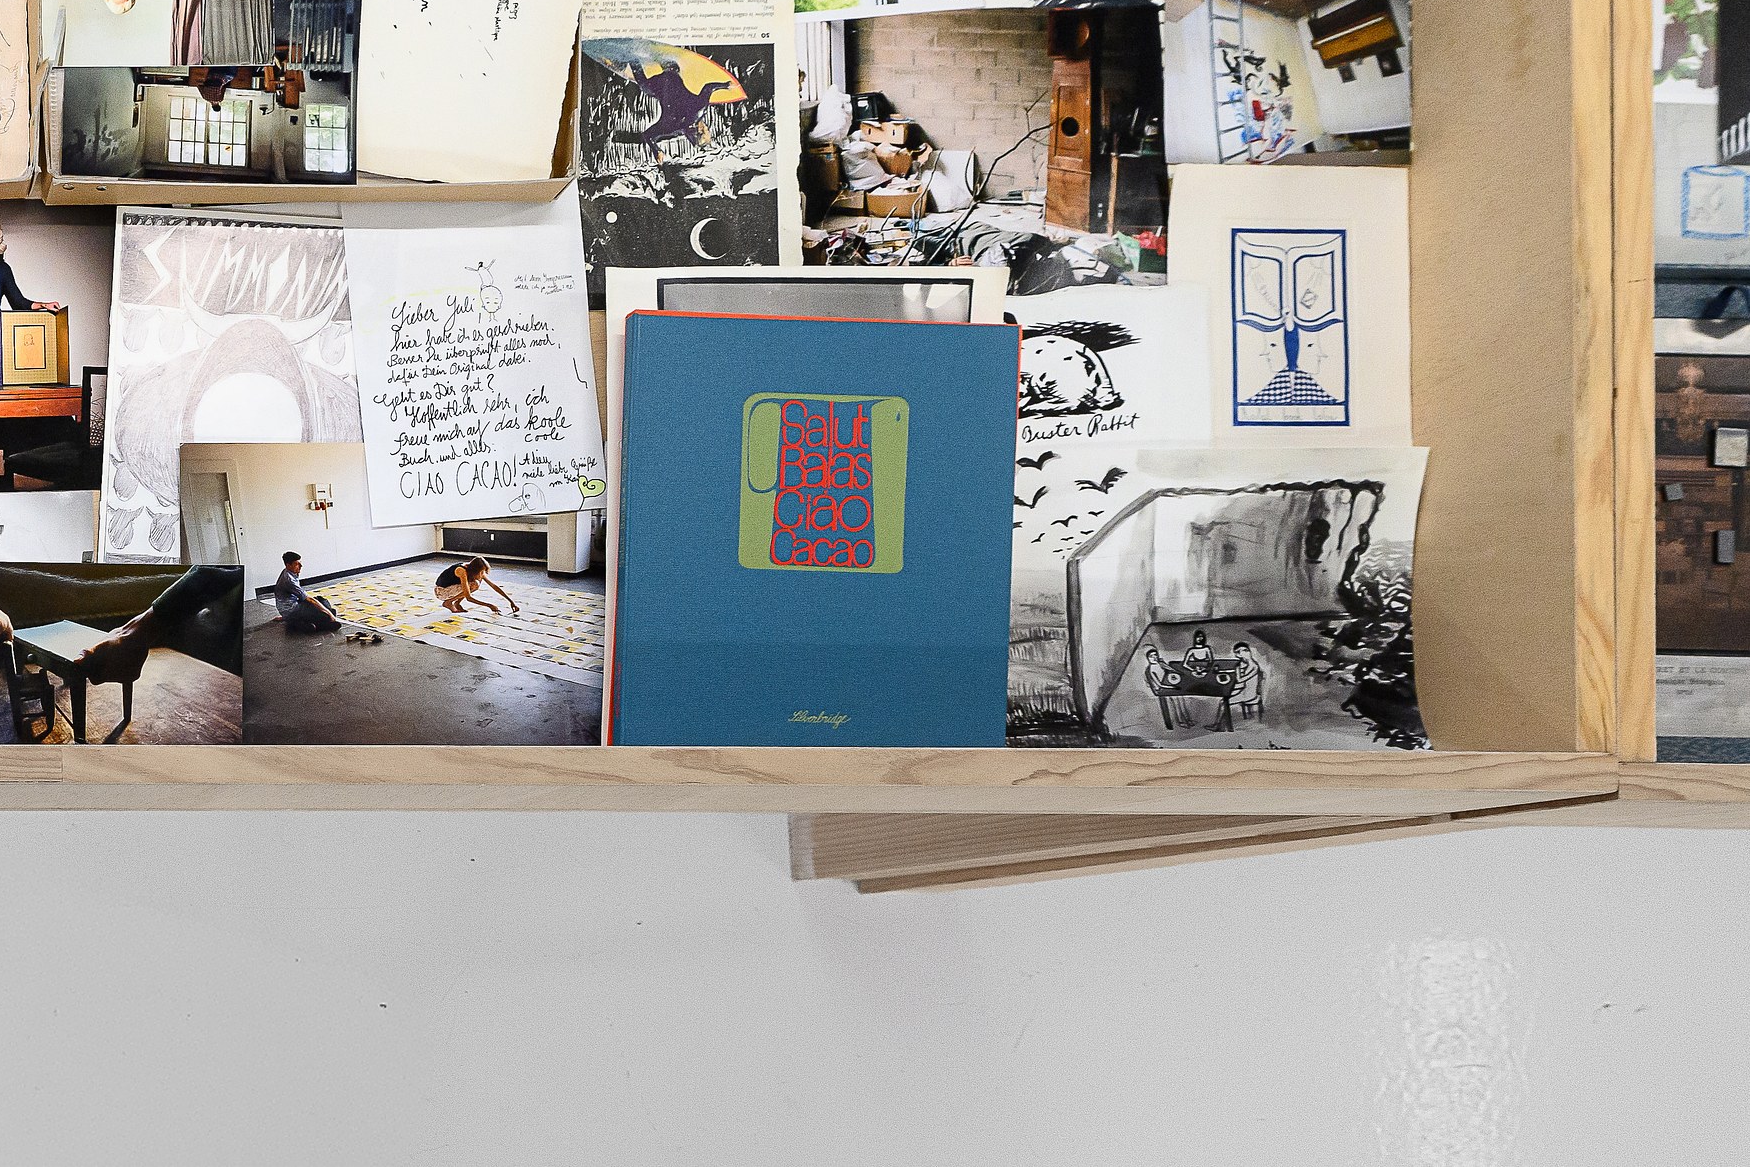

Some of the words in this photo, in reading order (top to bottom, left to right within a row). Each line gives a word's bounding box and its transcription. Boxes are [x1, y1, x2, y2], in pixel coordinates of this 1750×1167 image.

[780, 399, 869, 449] Salut
[399, 471, 444, 499] CIAO
[779, 444, 872, 490] Balas
[770, 528, 874, 568] Cacao
